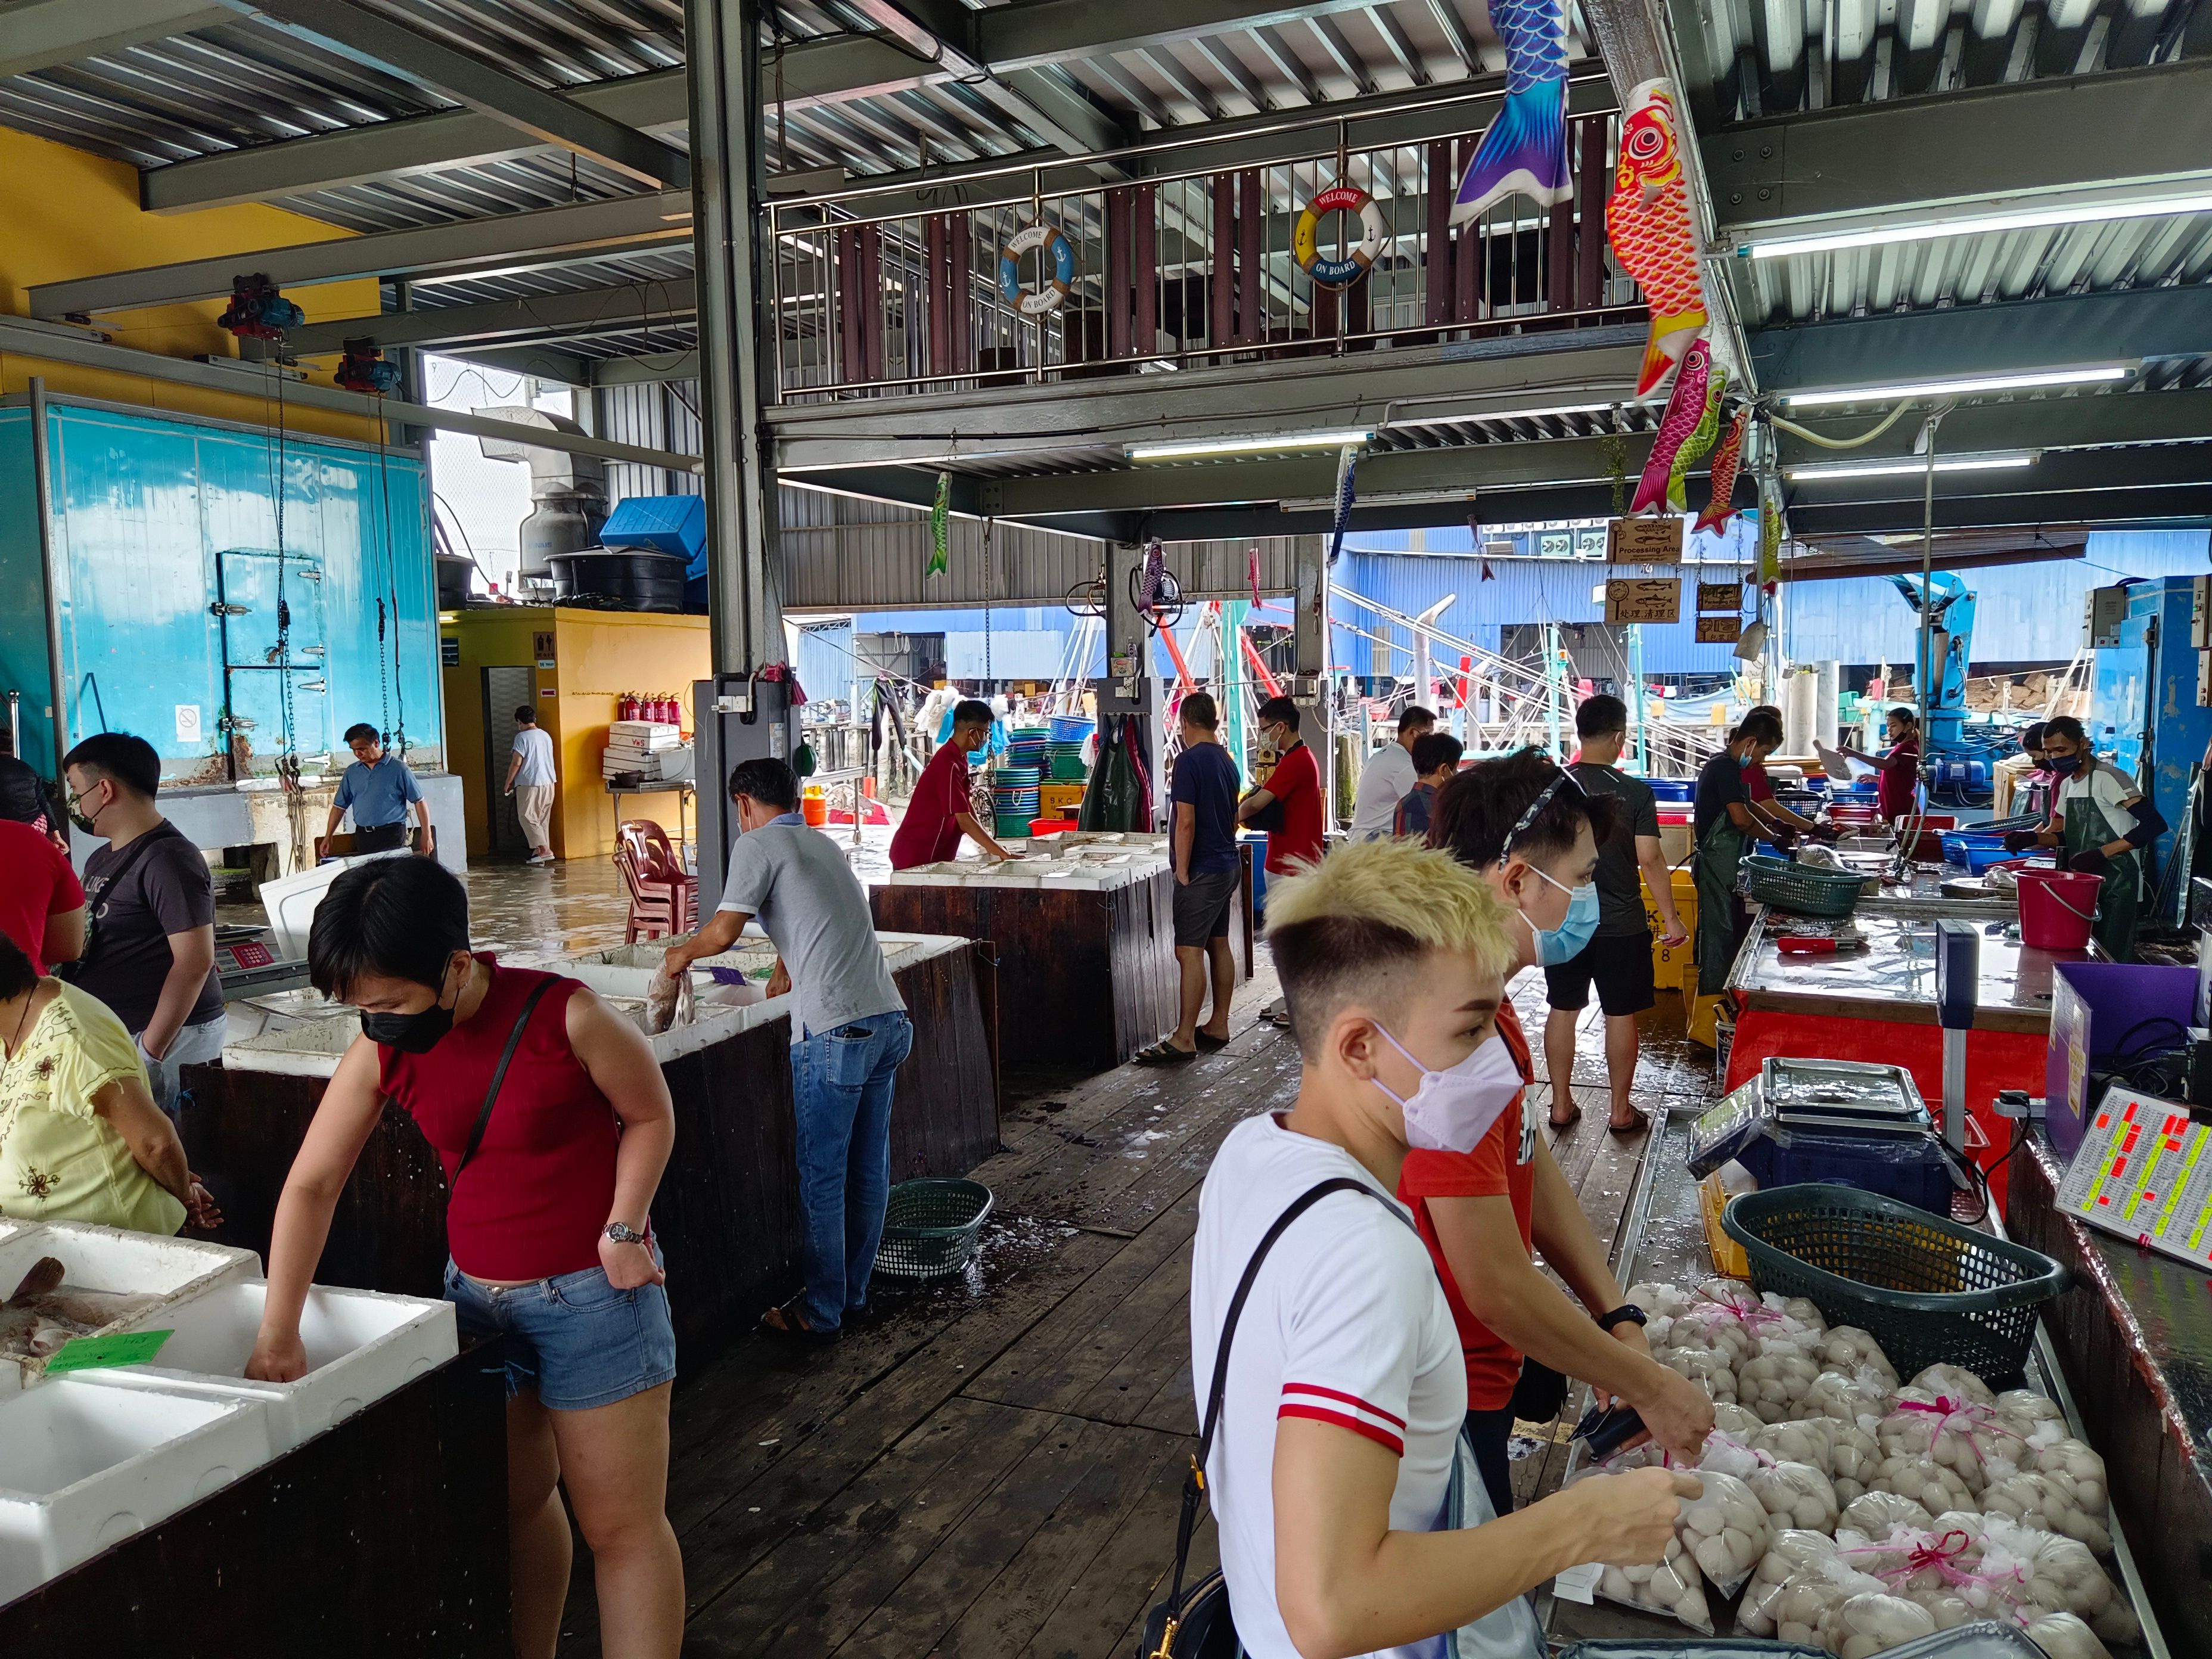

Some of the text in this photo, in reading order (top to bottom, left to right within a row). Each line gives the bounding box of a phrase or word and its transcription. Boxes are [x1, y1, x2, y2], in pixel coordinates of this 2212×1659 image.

[1319, 191, 1358, 205] WELCOME
[1011, 231, 1042, 248] WELCOME
[1316, 260, 1355, 275] ON BOARD
[1023, 290, 1055, 309] ON BOARD
